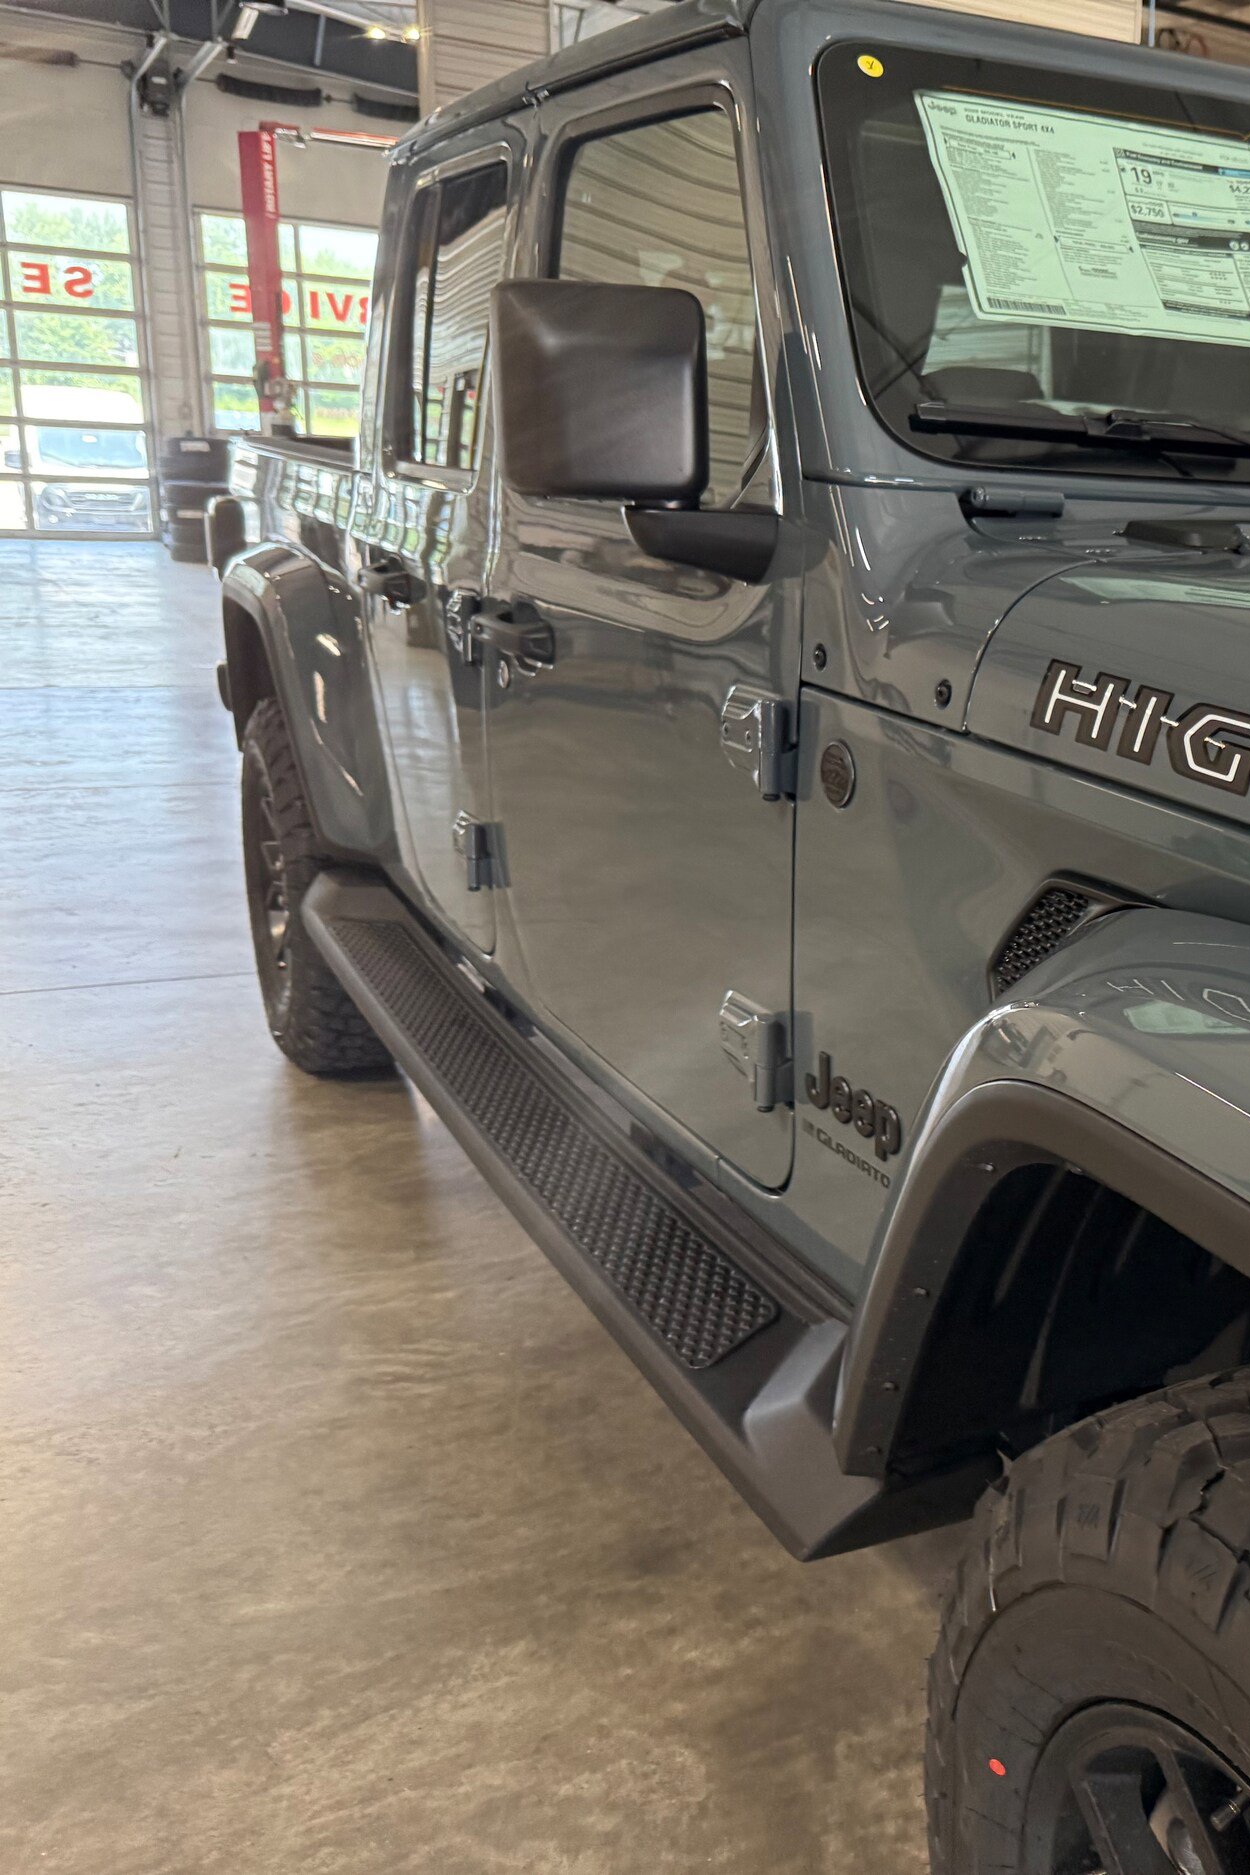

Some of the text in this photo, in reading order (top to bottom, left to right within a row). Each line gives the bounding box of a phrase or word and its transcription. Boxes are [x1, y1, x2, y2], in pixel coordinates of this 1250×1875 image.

[965, 114, 1012, 129] GLADIATOR
[1012, 120, 1038, 132] SPORT
[1130, 166, 1152, 185] 19
[1131, 204, 1165, 218] $2,750
[805, 1051, 901, 1162] Jeep
[816, 1127, 891, 1189] GLADIATO
